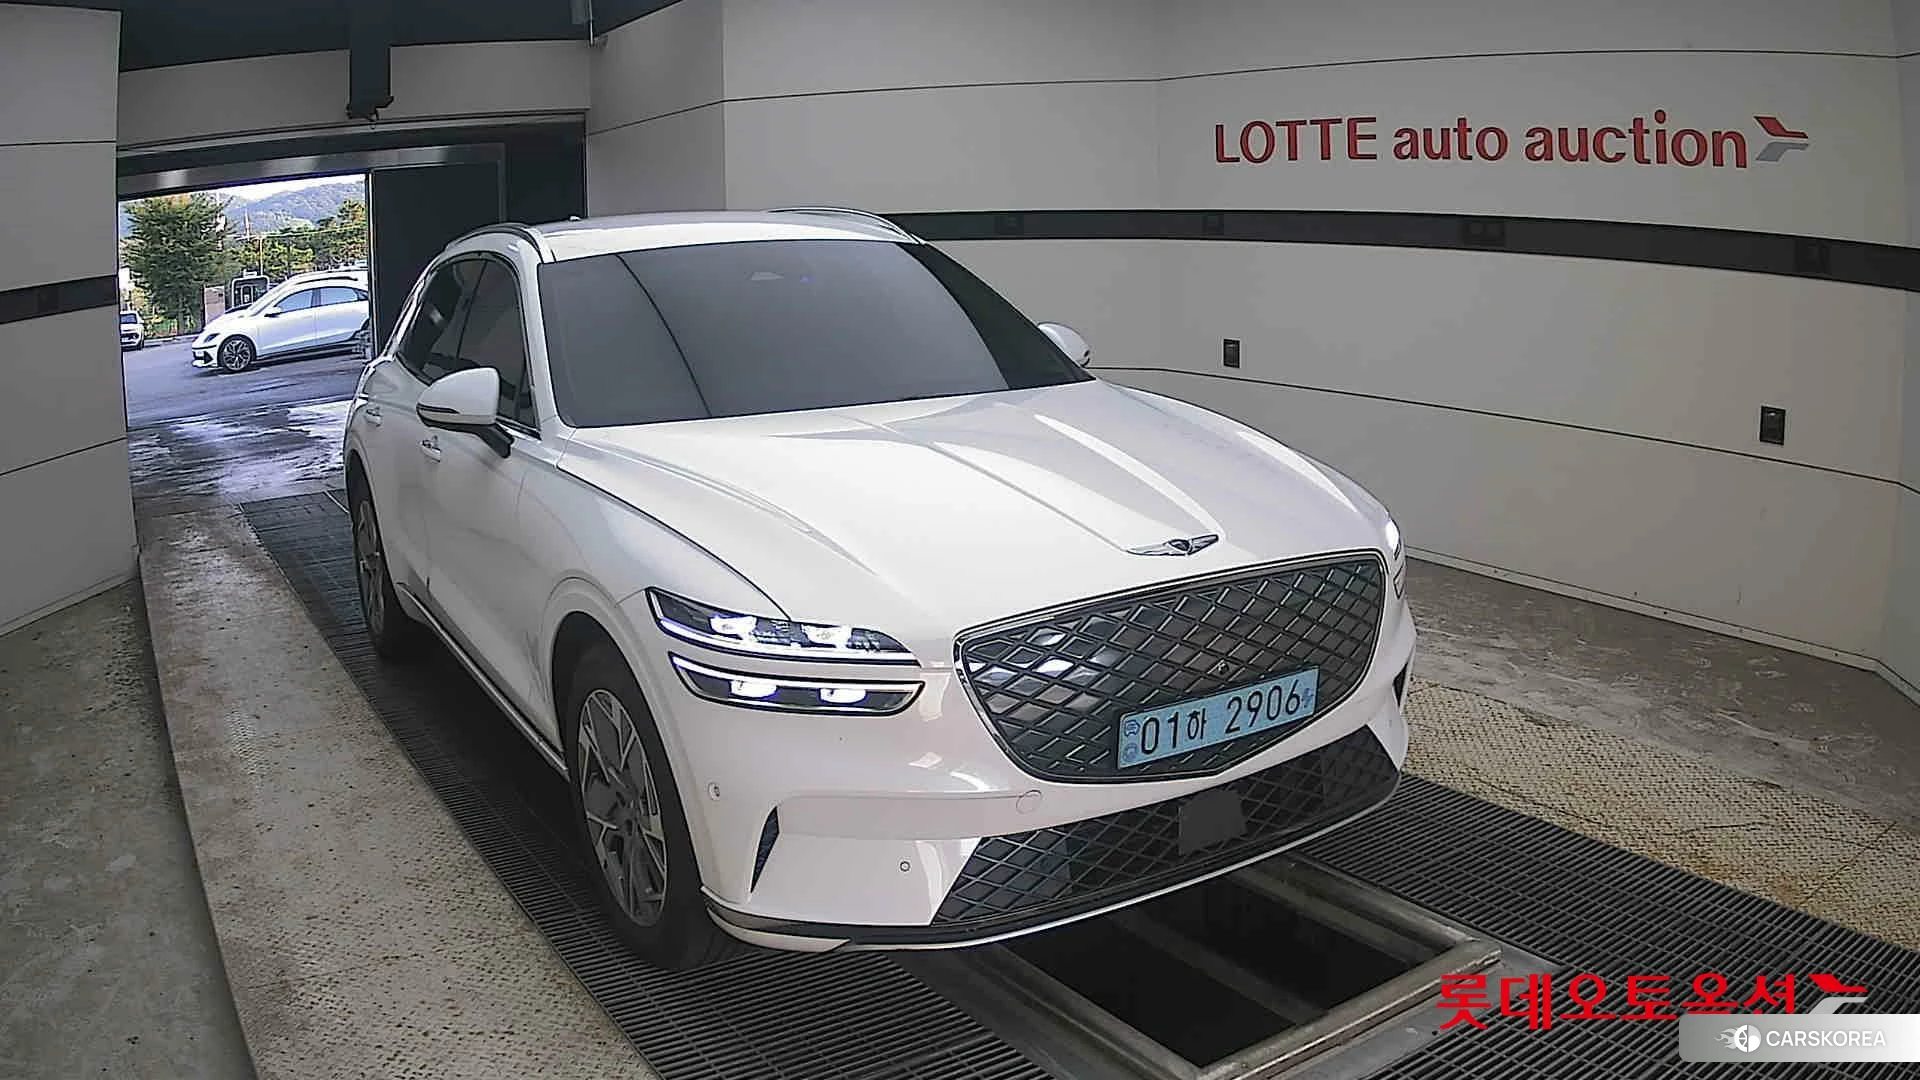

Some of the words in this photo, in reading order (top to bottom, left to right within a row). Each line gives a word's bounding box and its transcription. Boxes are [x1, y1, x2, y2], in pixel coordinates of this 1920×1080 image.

[1215, 117, 1377, 163] LOTTE
[1393, 117, 1509, 161] auto
[1524, 109, 1747, 168] auction
[1141, 708, 1207, 754] 01하
[1225, 679, 1301, 735] 2906
